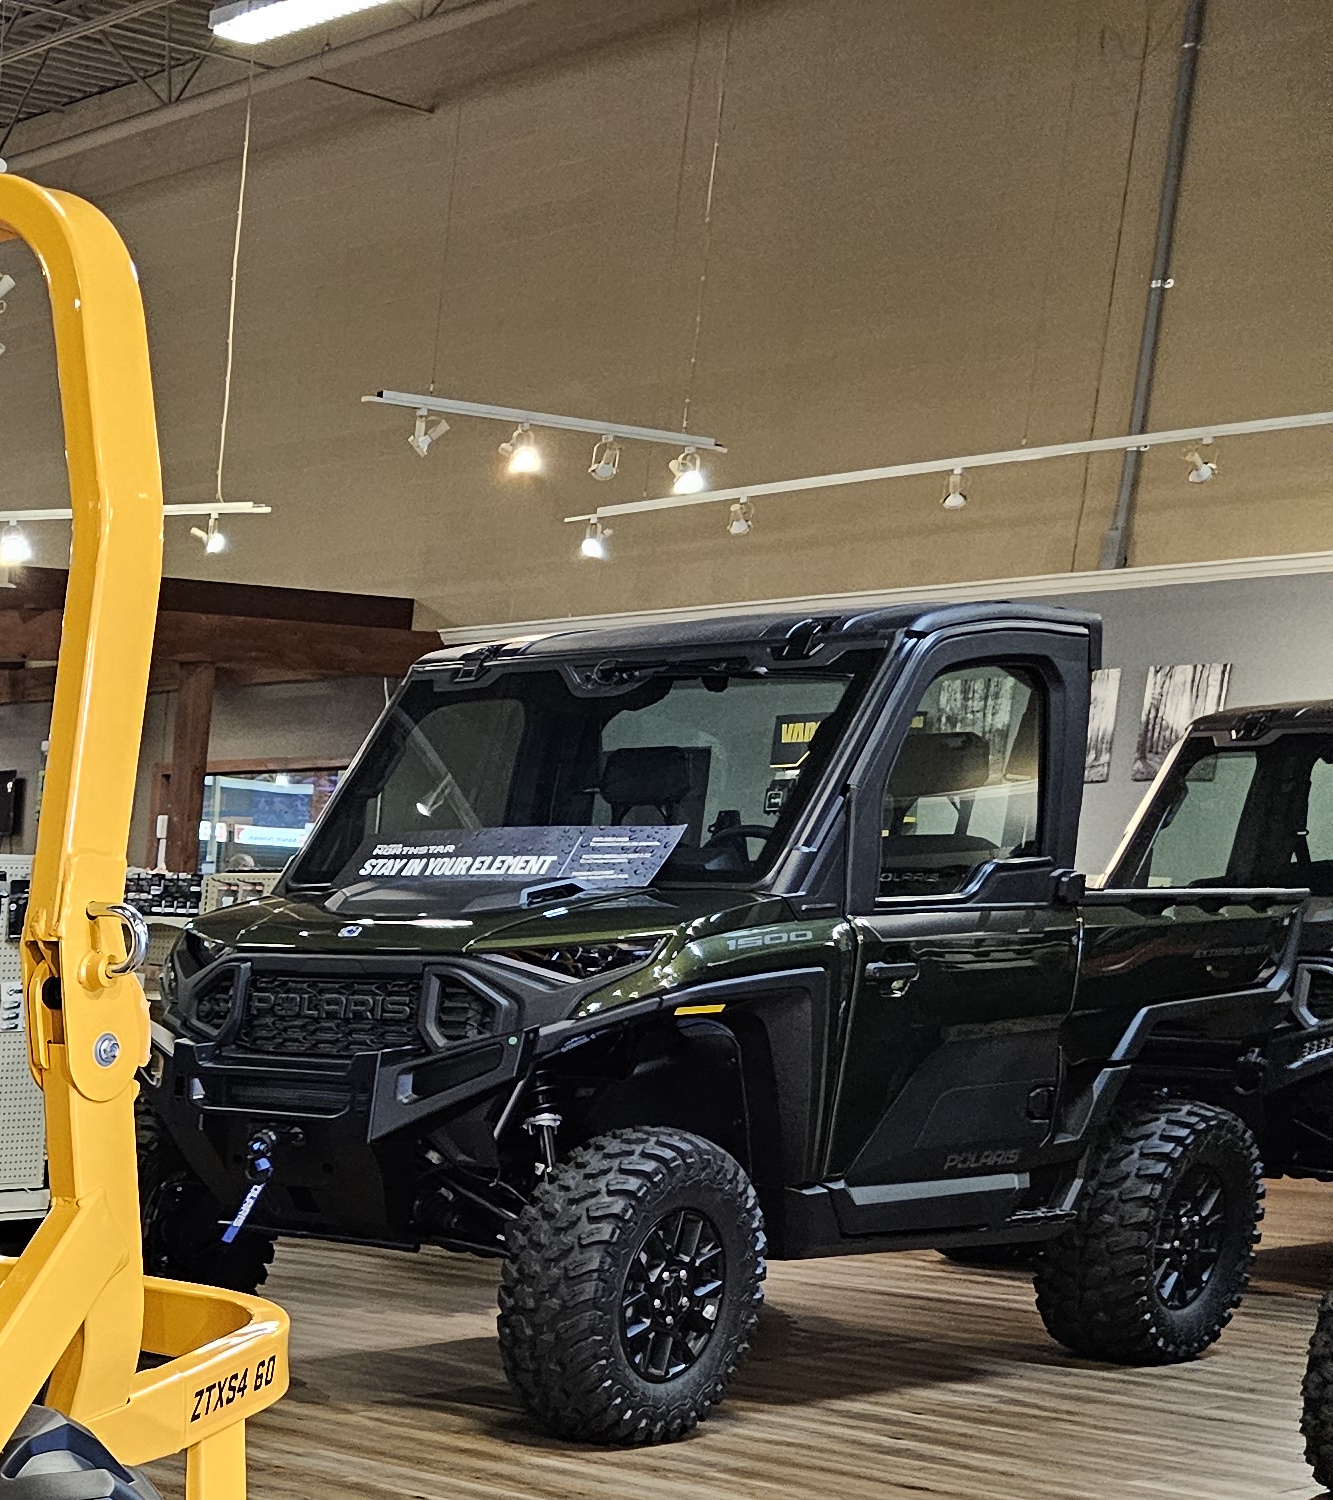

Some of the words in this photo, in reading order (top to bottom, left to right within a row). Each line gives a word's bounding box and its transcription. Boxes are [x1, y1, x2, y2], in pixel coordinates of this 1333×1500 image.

[359, 857, 406, 876] STAY
[401, 857, 428, 877] IN
[424, 856, 471, 876] YOUR
[468, 855, 559, 876] ELEMENT
[879, 872, 940, 882] OLARIS
[726, 929, 813, 951] 1500
[252, 992, 411, 1021] POLARIS
[943, 1147, 1022, 1170] POLARIS
[232, 1184, 263, 1227] OLARIS
[190, 1367, 249, 1423] ZTXS4
[253, 1354, 276, 1392] 60
